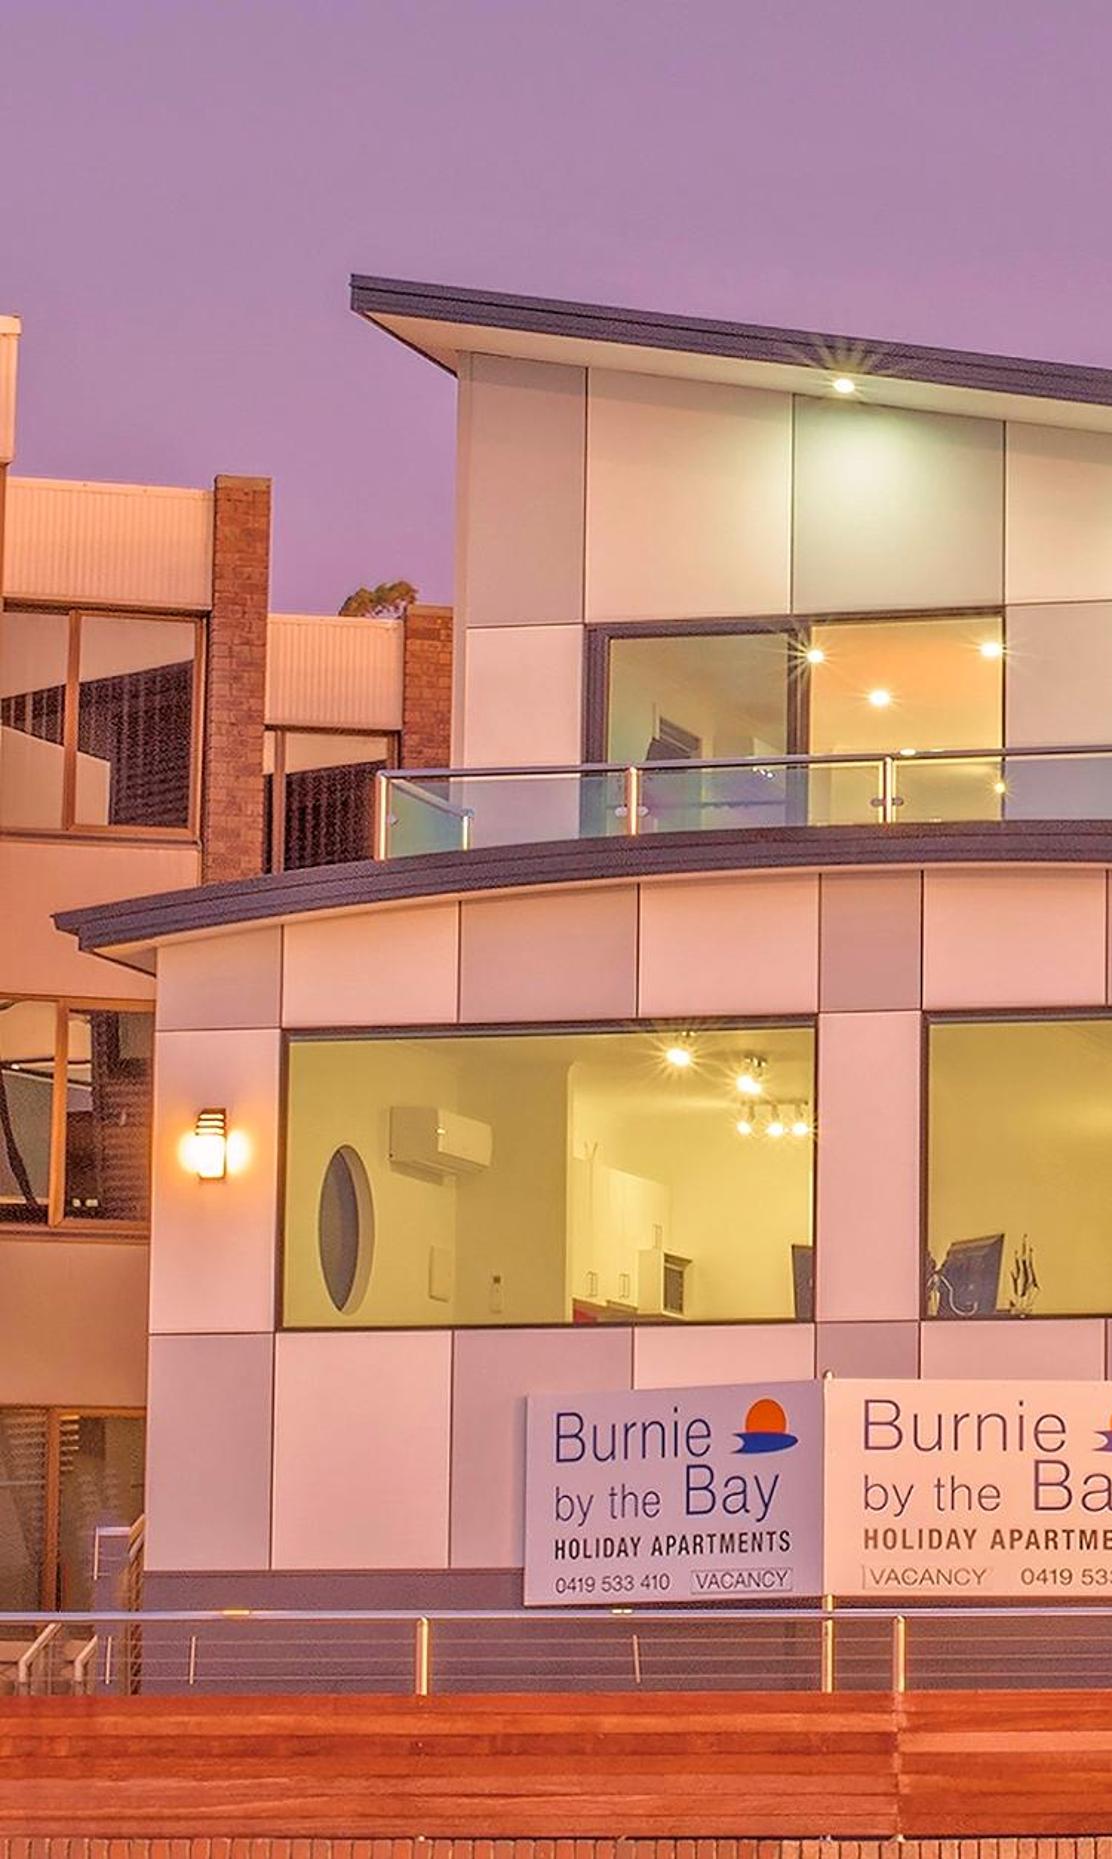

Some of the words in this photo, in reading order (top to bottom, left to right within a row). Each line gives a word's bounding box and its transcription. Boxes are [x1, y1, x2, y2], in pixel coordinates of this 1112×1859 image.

[555, 1406, 712, 1463] Burnie
[864, 1399, 1067, 1452] Burnie
[555, 1486, 594, 1527] by
[608, 1483, 661, 1519] the
[685, 1464, 780, 1523] Bay
[864, 1474, 914, 1517] by
[934, 1475, 1001, 1512] the
[554, 1537, 641, 1560] HOLIDAY
[651, 1530, 791, 1557] APARTMENTS
[864, 1528, 977, 1551] HOLIDAY
[555, 1576, 596, 1594] 0419
[601, 1575, 634, 1592] 533
[640, 1573, 671, 1591] 410
[695, 1570, 788, 1591] VACANCY
[869, 1567, 987, 1587] VACANCY
[1020, 1567, 1073, 1587] 0419
